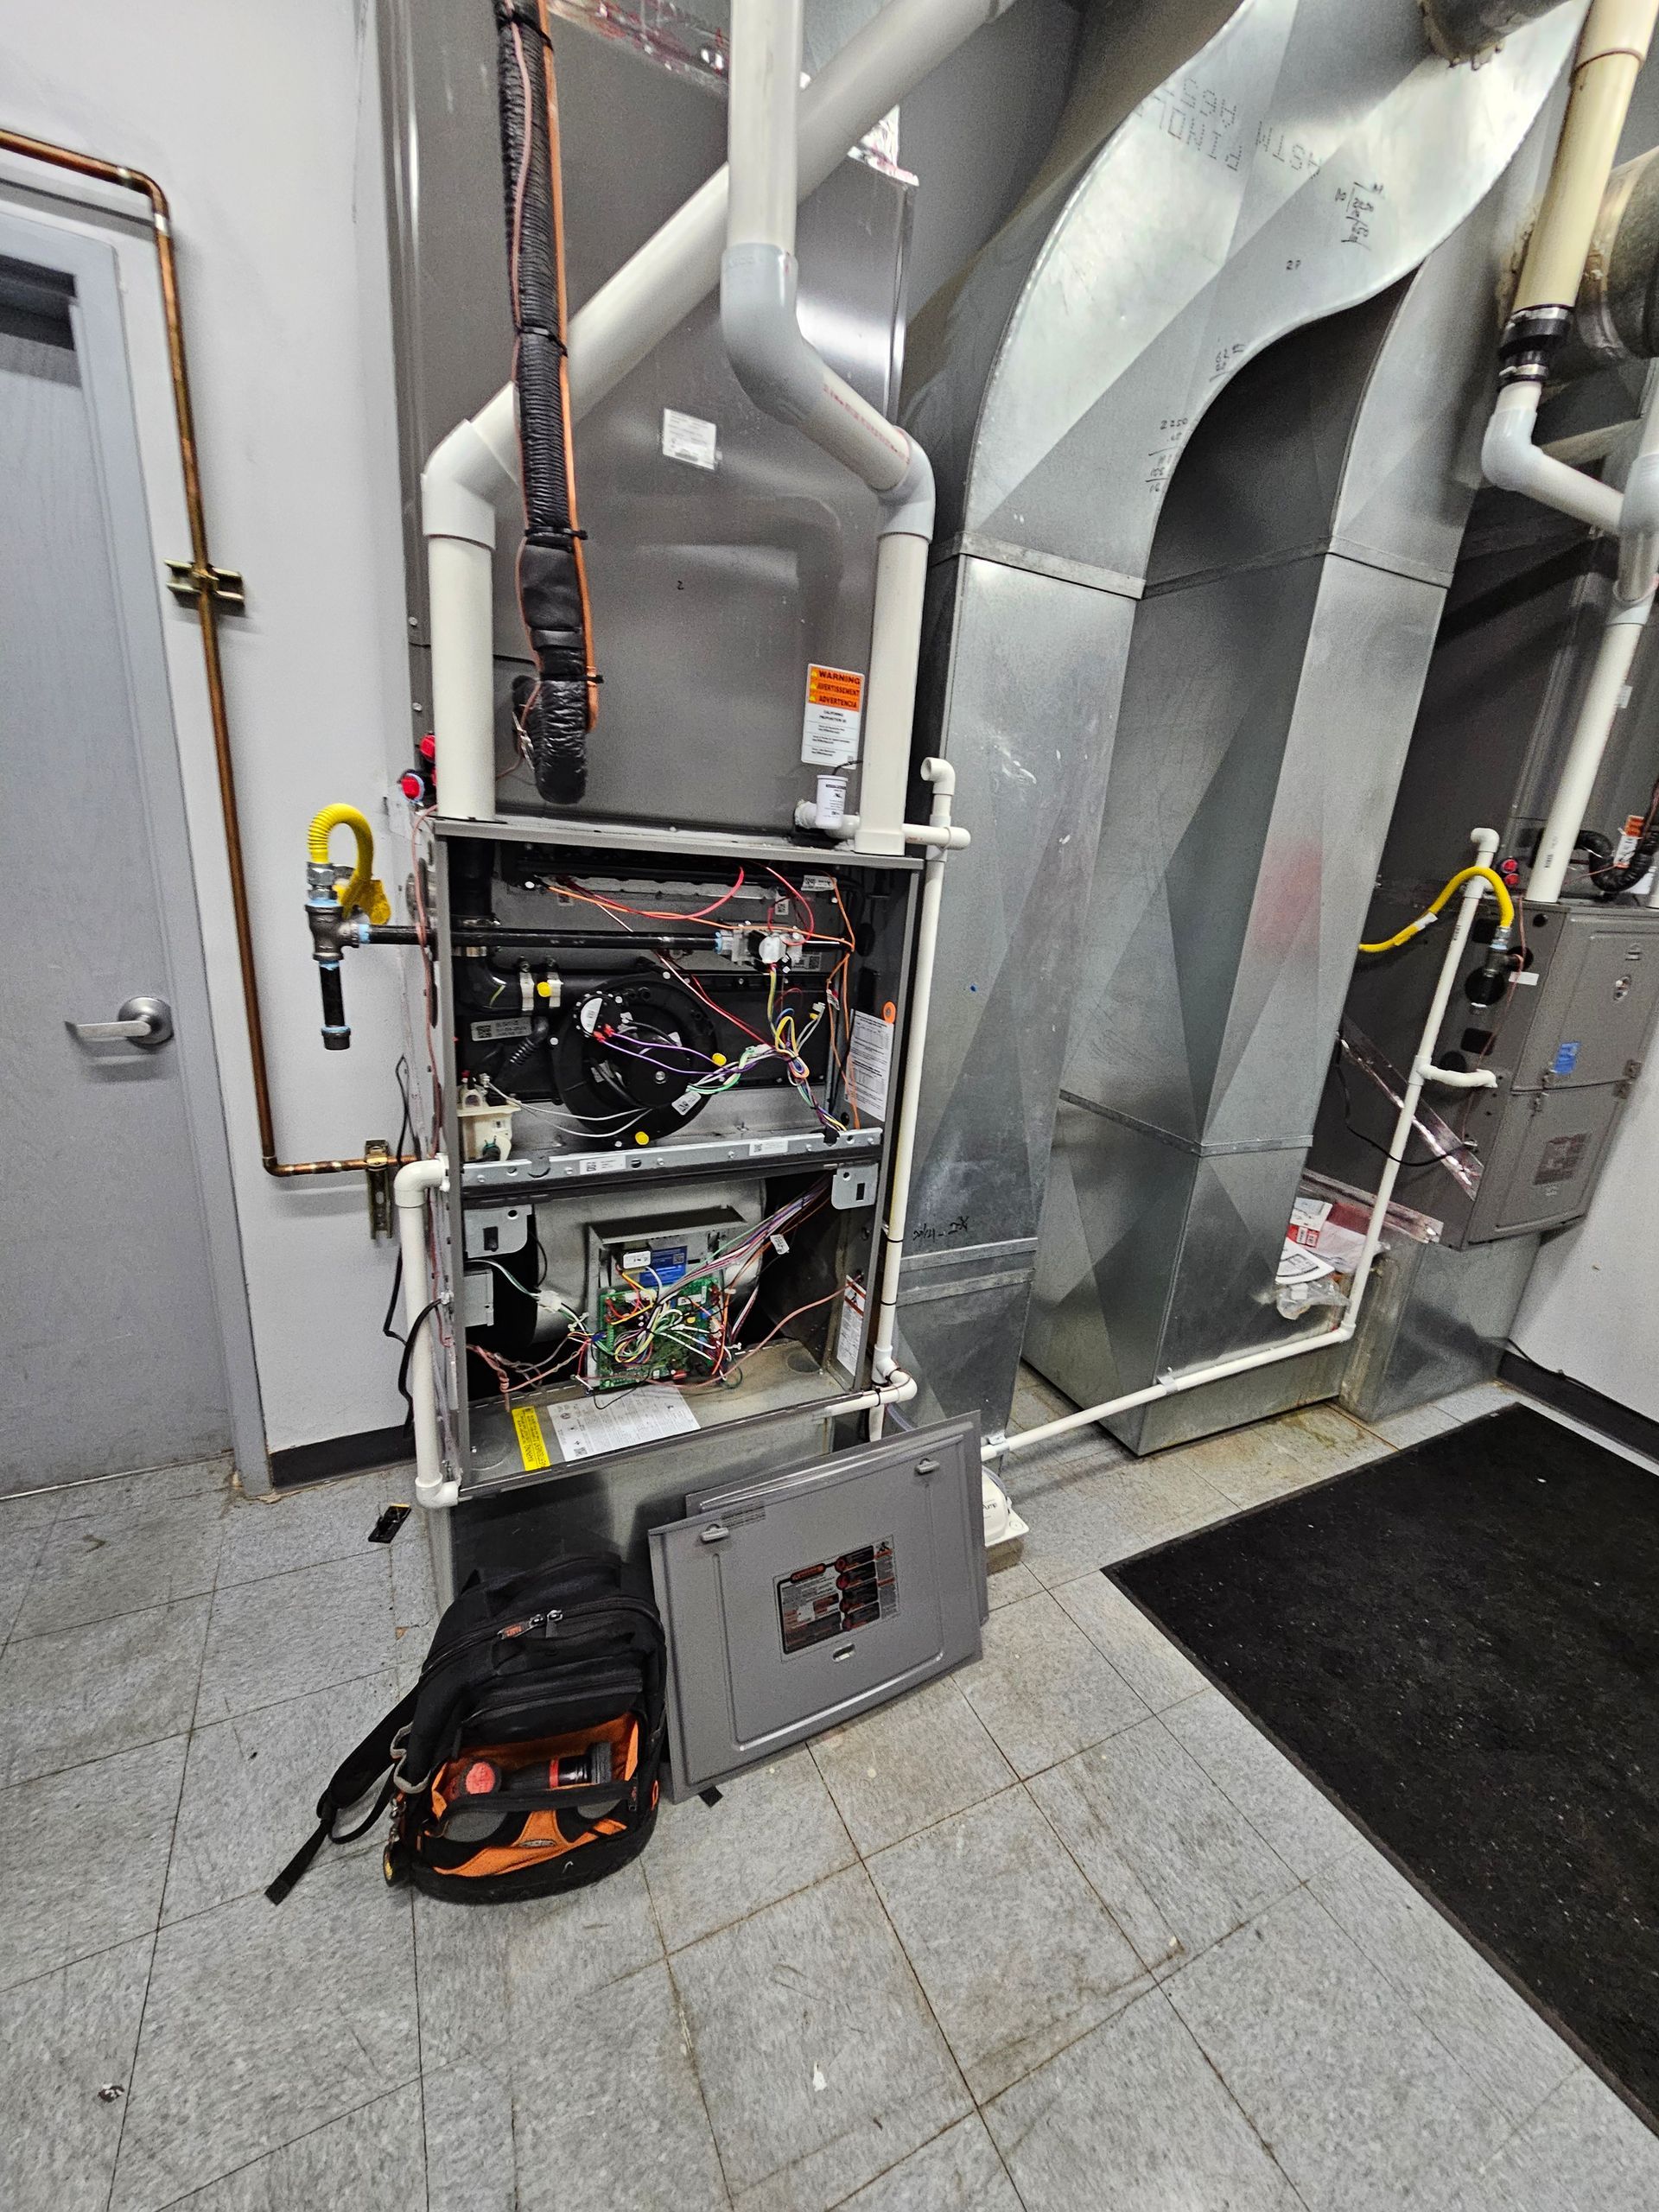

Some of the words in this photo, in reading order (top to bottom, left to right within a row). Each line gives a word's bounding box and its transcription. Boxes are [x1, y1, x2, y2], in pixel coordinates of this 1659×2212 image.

[1164, 78, 1236, 129] A65
[818, 670, 861, 684] WARNING
[817, 683, 860, 696] AVERTISSEMENT
[818, 696, 857, 709] ADVERTENCIA
